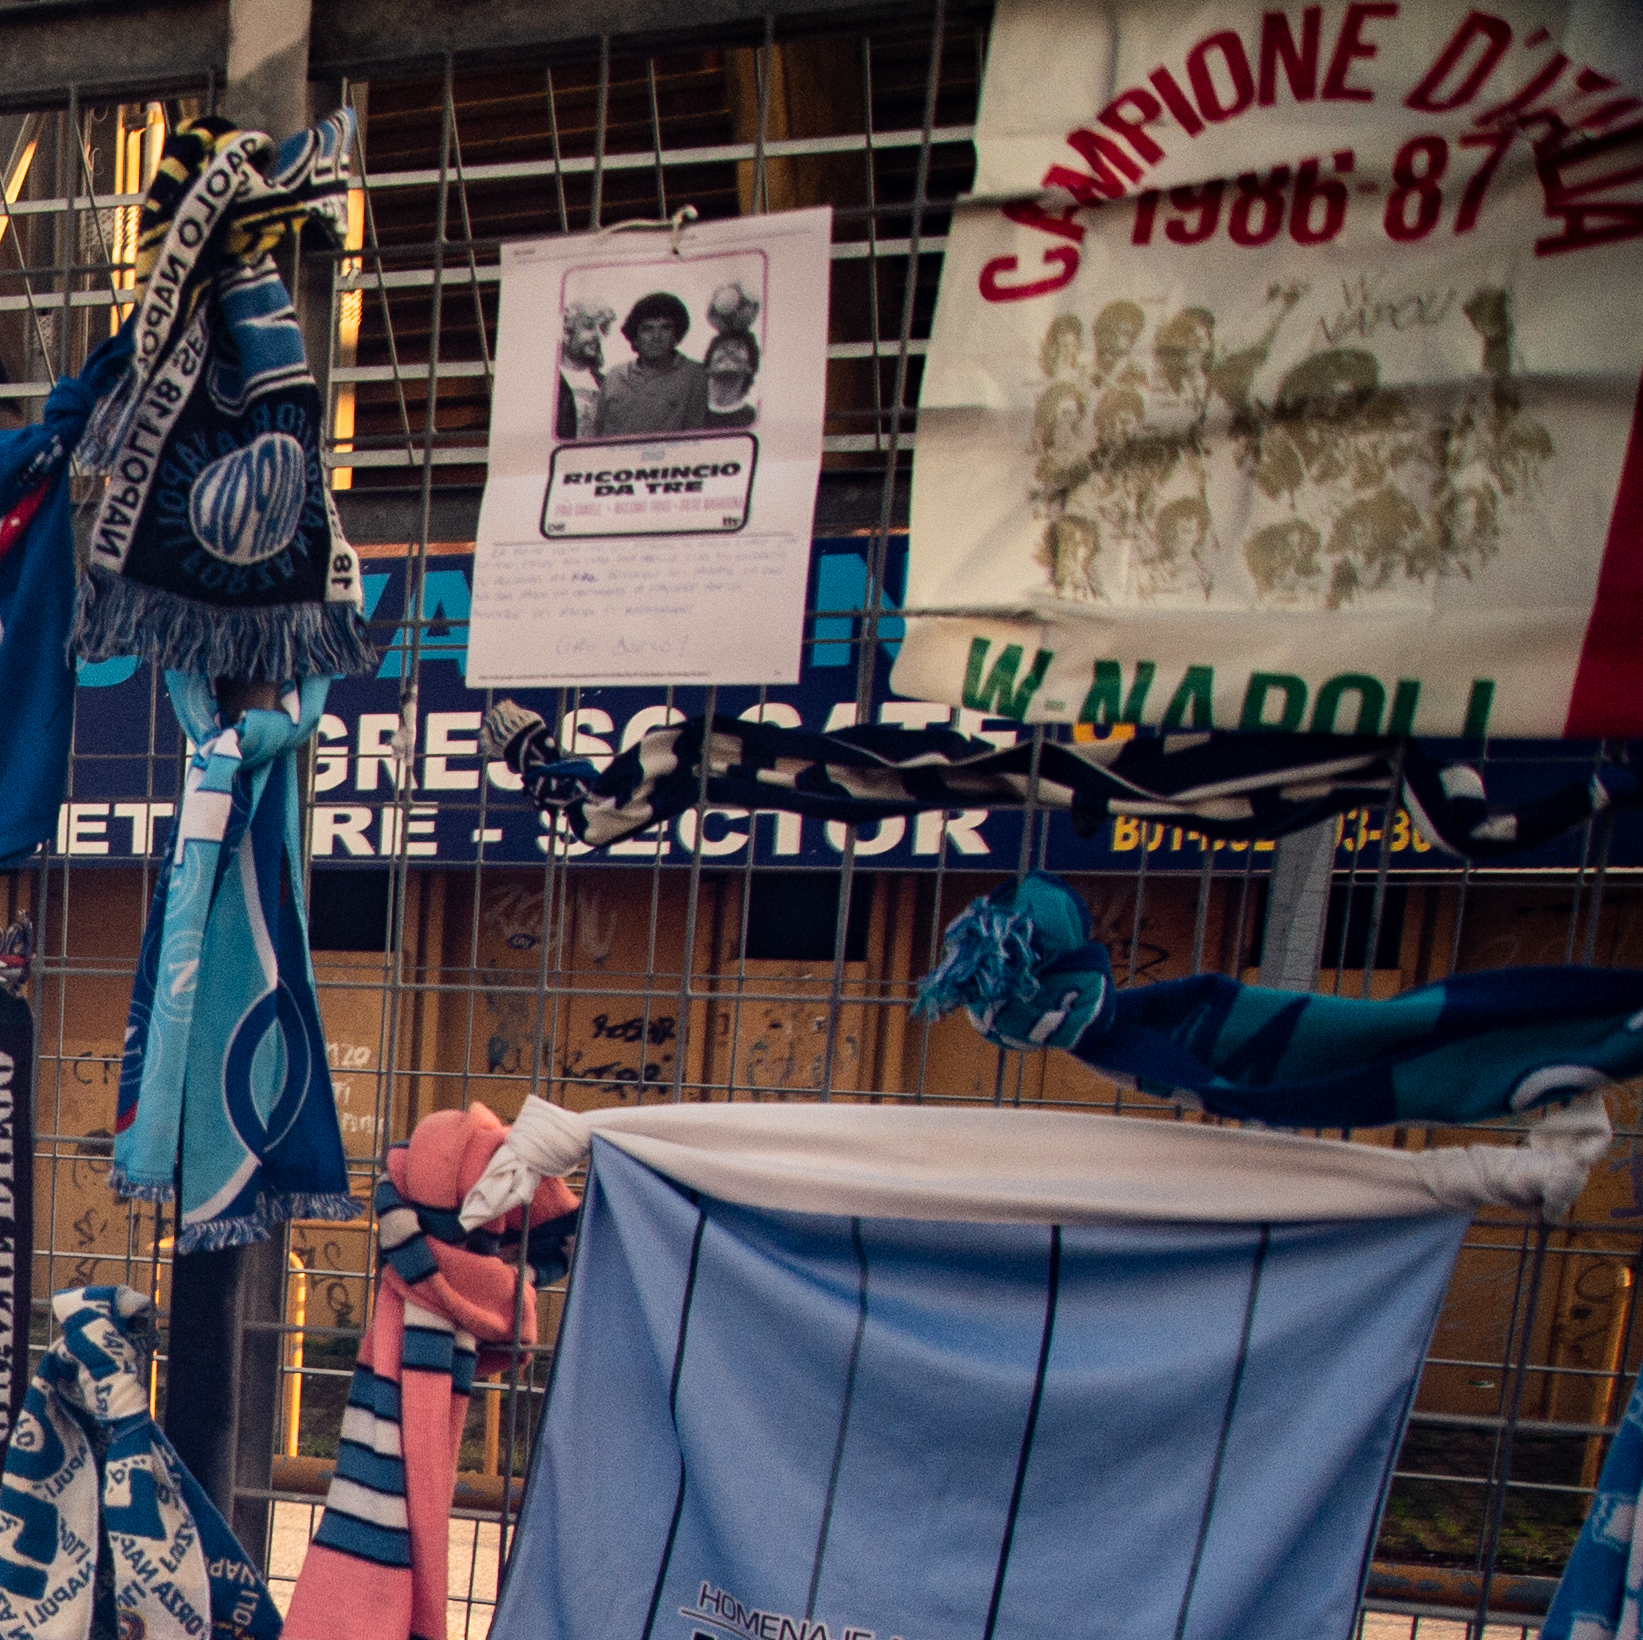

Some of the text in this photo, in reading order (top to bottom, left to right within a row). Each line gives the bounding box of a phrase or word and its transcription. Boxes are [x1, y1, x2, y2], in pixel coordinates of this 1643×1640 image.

[977, 3, 1398, 304] CAMPIONE
[563, 462, 742, 485] RICOMINCIO
[594, 481, 703, 497] DA TRE
